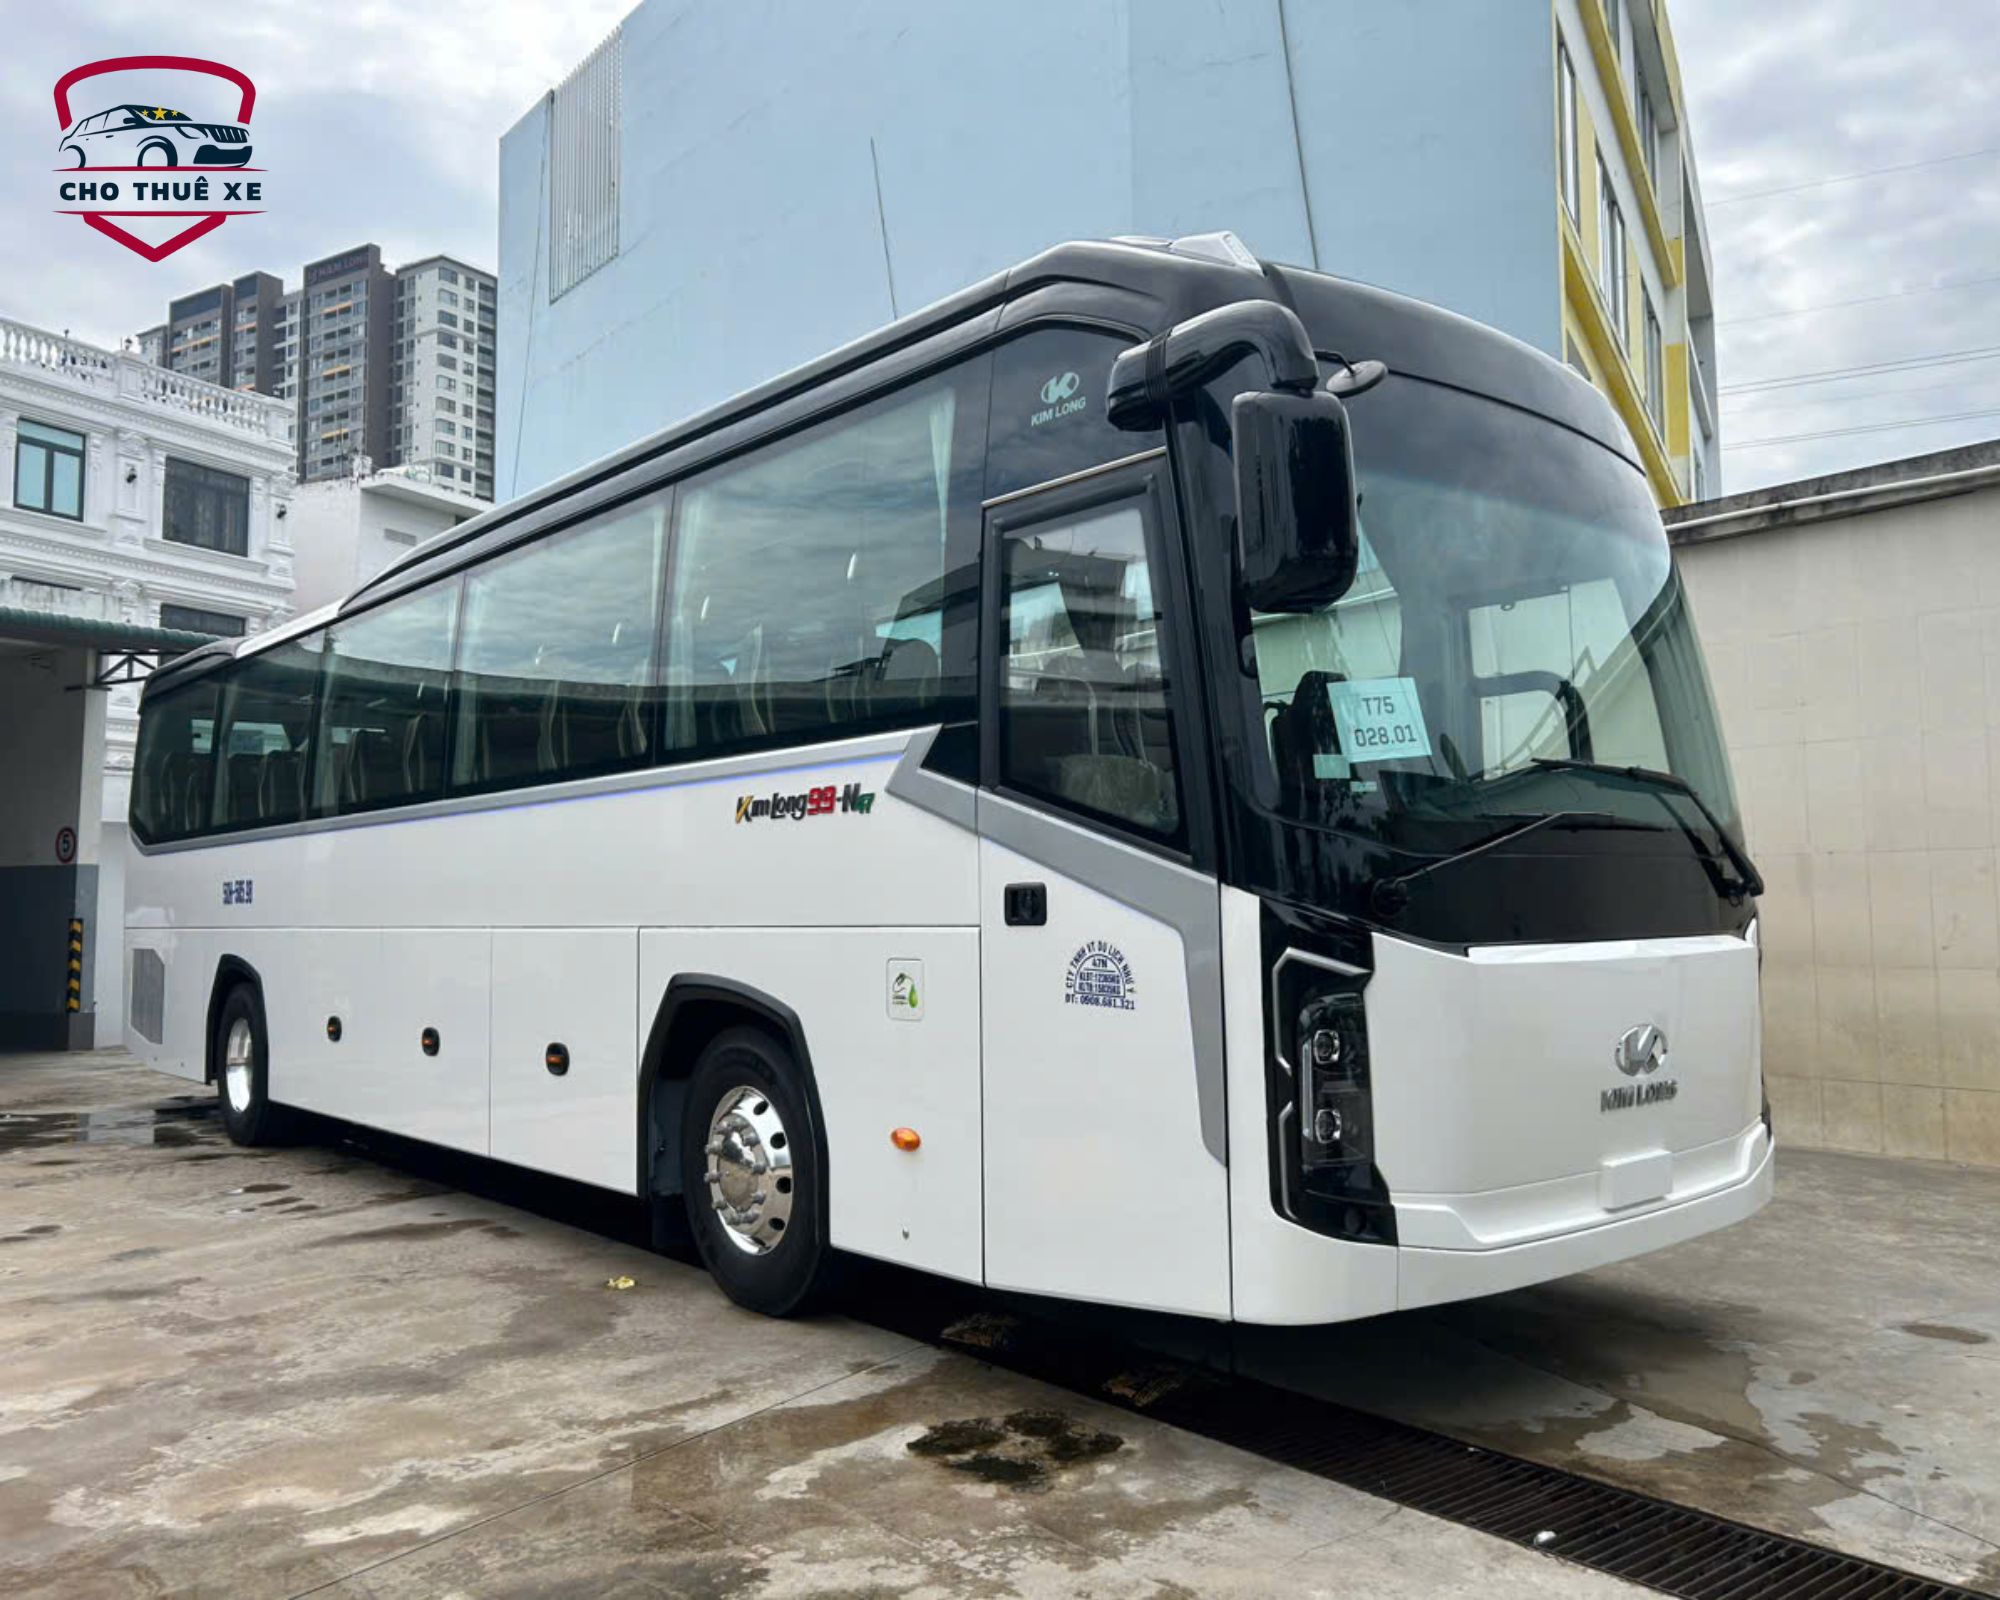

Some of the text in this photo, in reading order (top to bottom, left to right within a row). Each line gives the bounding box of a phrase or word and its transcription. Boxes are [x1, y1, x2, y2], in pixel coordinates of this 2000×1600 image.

[1031, 396, 1086, 426] KIM LONG
[1361, 695, 1395, 715] T75
[1354, 724, 1417, 747] 028.01
[1601, 1080, 1677, 1112] KIM LONG
